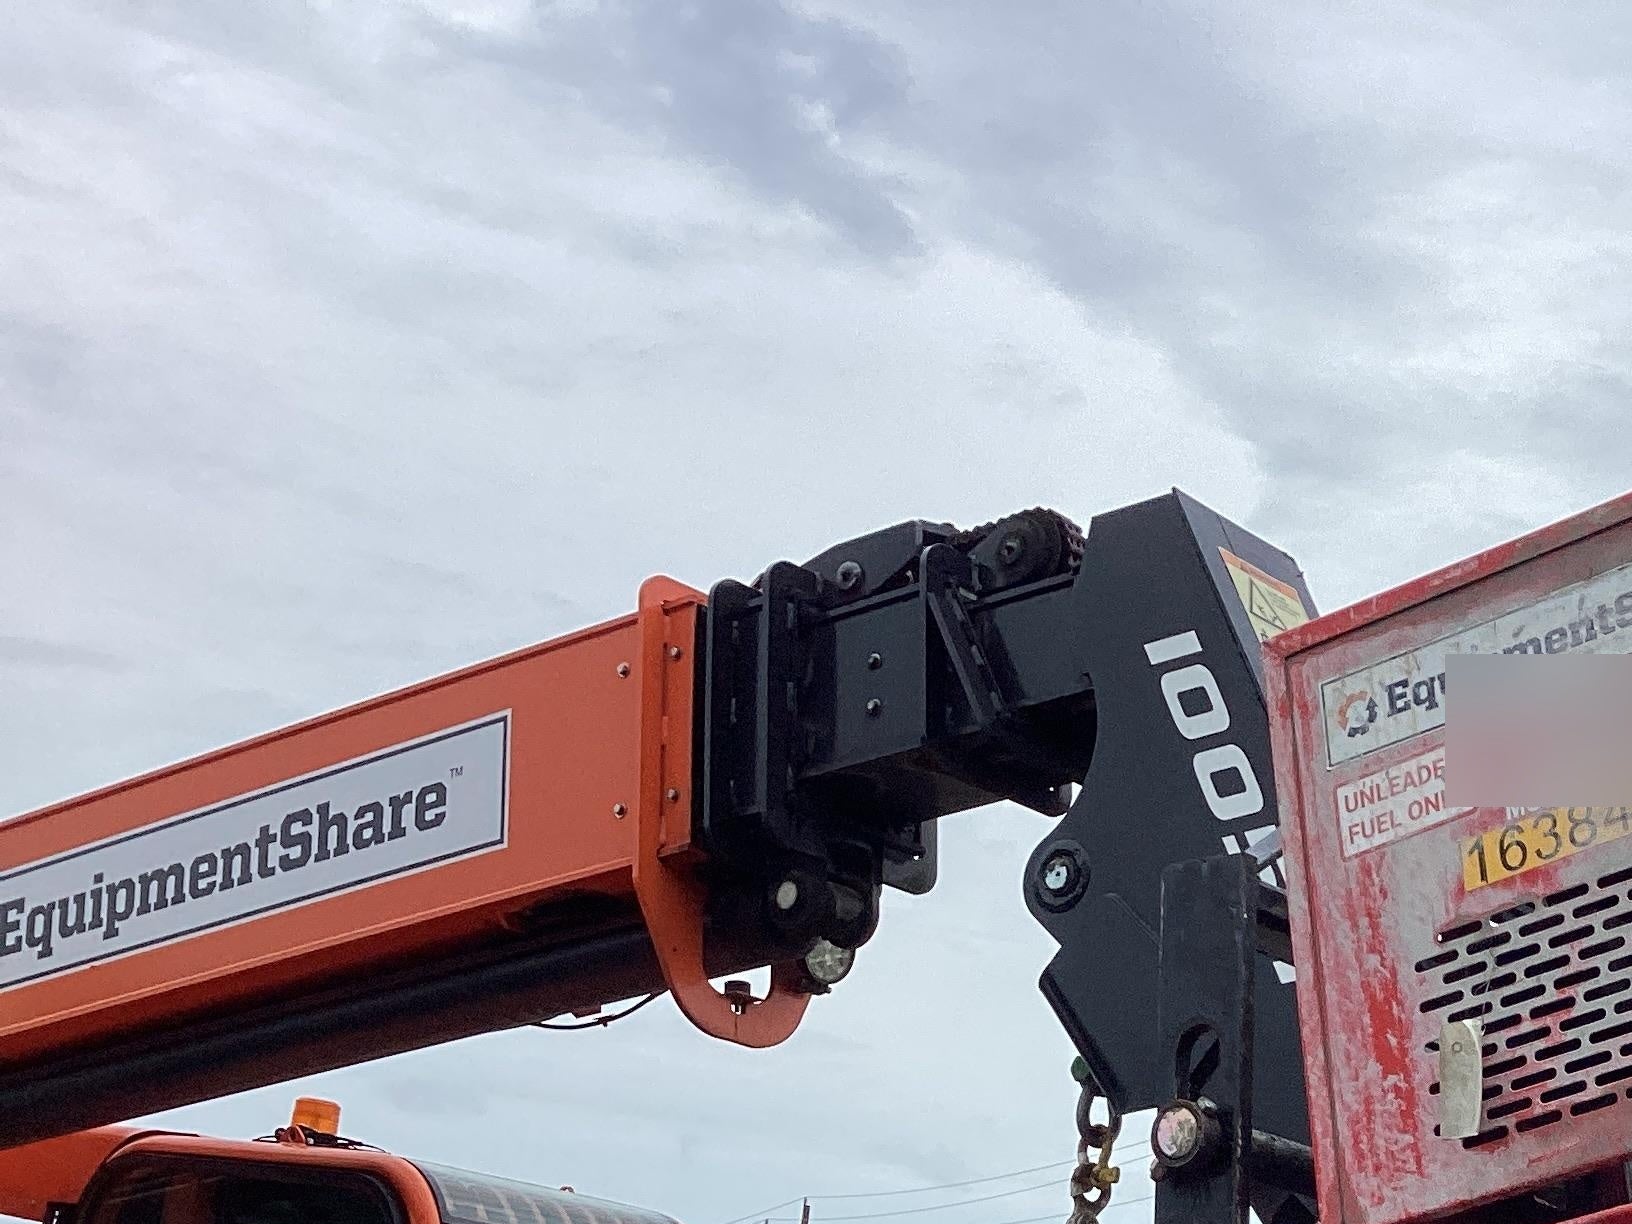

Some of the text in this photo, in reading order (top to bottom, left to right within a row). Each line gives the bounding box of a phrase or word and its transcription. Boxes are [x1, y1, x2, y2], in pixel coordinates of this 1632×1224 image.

[1344, 757, 1445, 813] UNLEADE
[1348, 790, 1445, 845] FUEL ON
[0, 781, 448, 959] EquipmentShare
